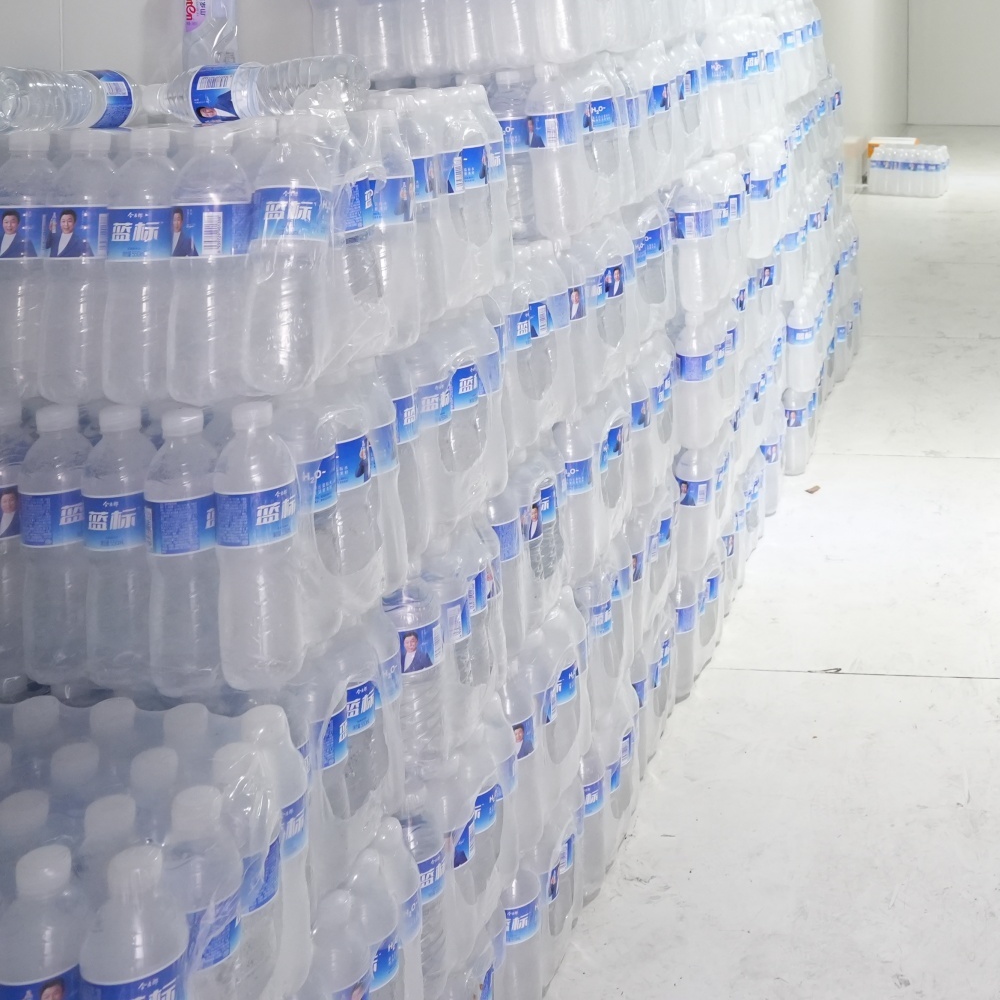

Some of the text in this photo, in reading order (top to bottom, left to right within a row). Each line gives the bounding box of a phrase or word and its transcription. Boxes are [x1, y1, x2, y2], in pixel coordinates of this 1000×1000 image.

[264, 201, 314, 222] 蓝标
[111, 222, 160, 242] 蓝标
[458, 374, 478, 394] 蓝
[59, 502, 84, 526] 蓝
[88, 508, 137, 531] 蓝标
[256, 495, 296, 526] 蓝标
[283, 811, 305, 840] 标
